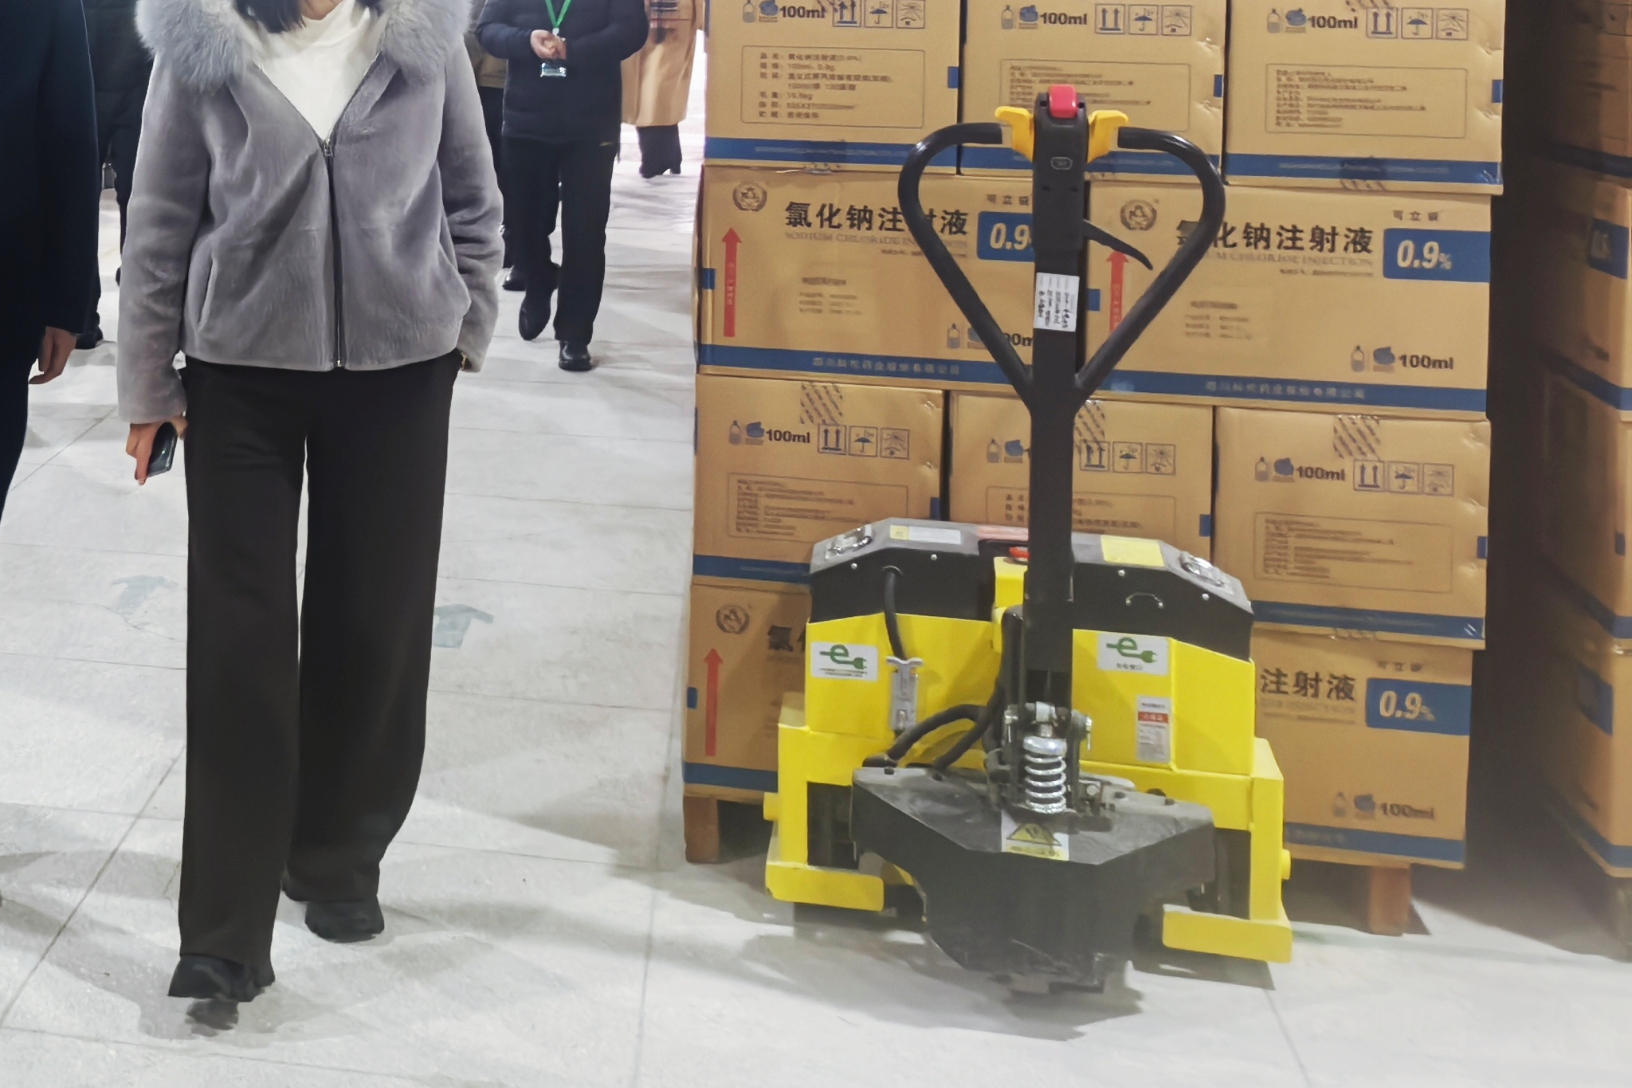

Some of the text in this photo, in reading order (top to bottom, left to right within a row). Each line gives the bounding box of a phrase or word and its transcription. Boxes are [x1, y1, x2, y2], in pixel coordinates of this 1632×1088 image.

[779, 4, 825, 20] 100ml
[1039, 12, 1087, 26] 100ml
[1308, 16, 1358, 30] 100ml
[990, 222, 1032, 250] 0.9
[1176, 221, 1373, 254] 化钠注射液
[1397, 241, 1451, 269] 0.9%
[1400, 354, 1454, 370] 100ml
[766, 428, 811, 444] 100ml
[1296, 465, 1346, 482] 100ml
[1260, 668, 1356, 701] 注射液
